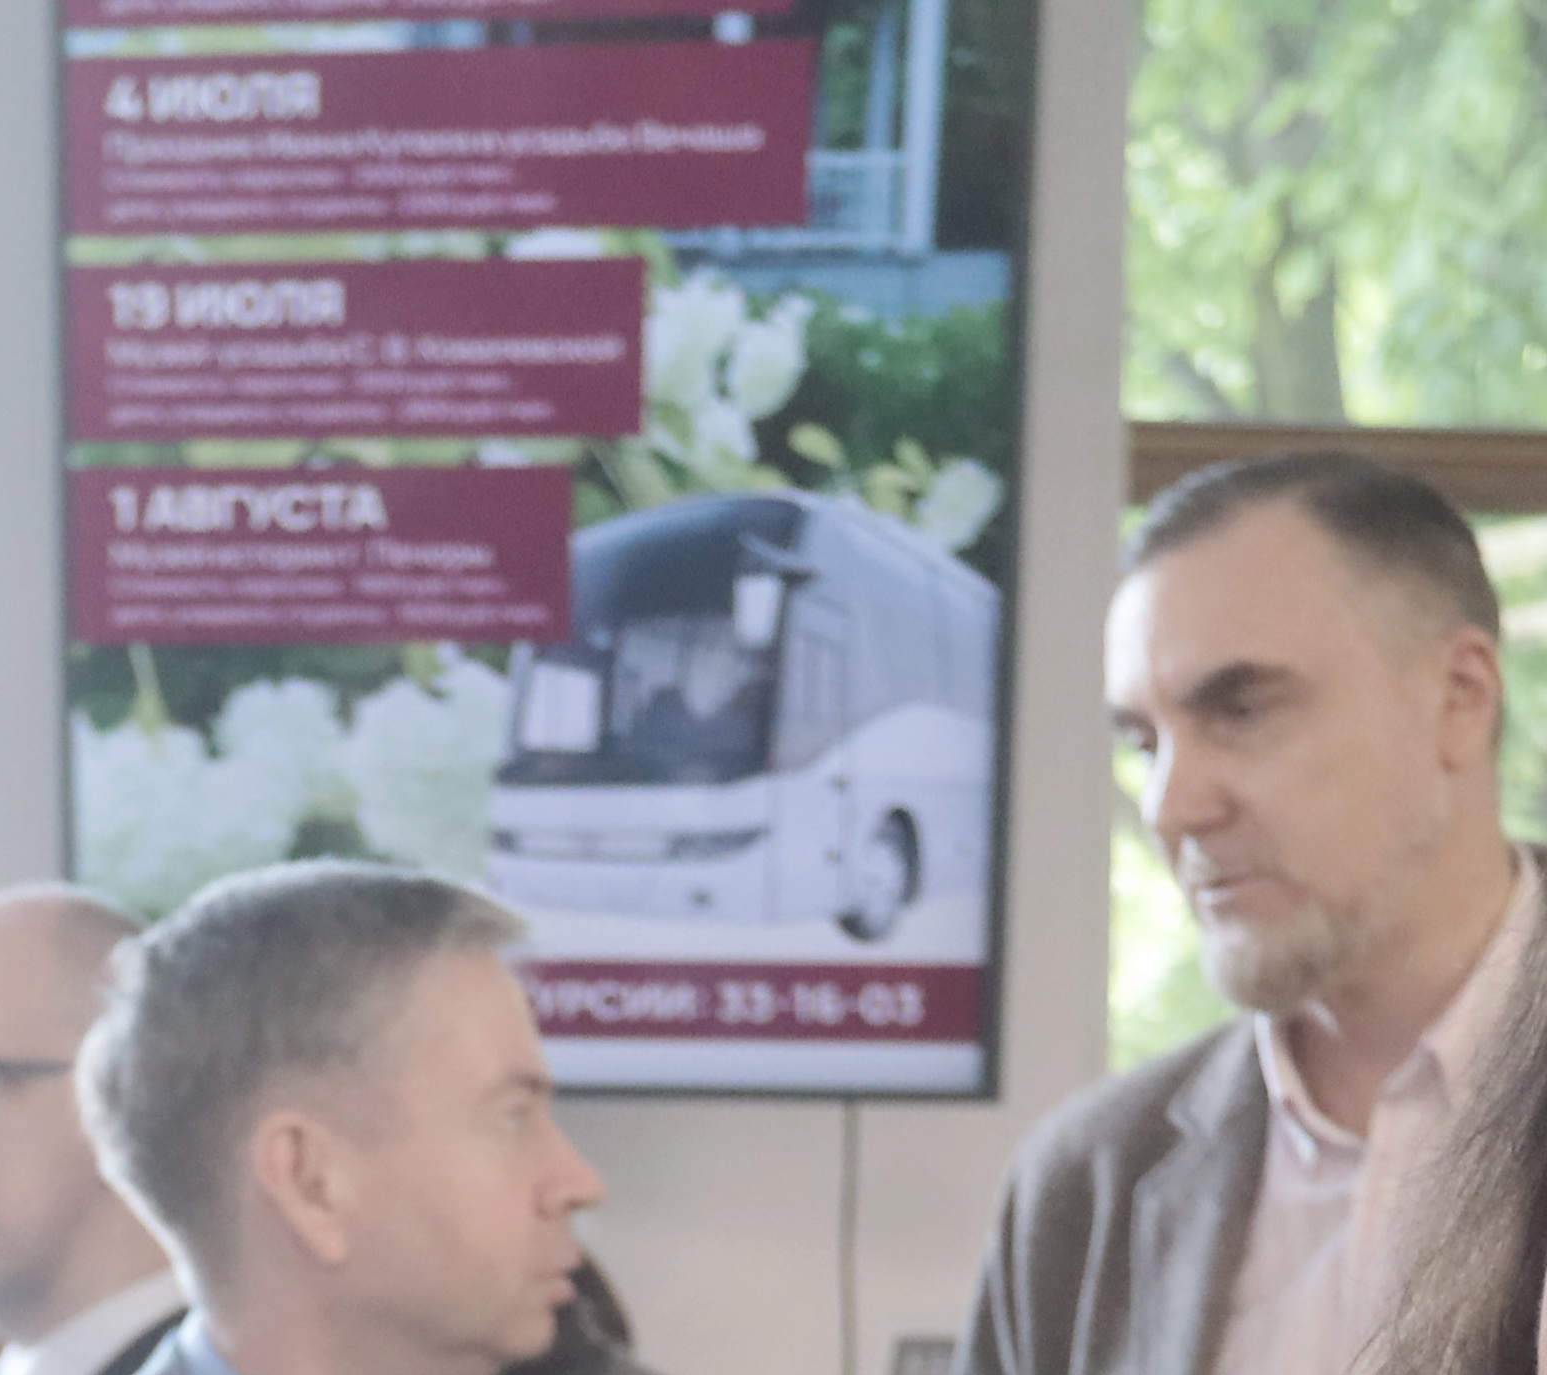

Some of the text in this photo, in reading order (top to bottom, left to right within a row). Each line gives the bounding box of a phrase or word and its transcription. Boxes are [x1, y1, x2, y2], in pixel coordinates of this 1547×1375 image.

[104, 71, 321, 123] 4 ИЮЛЯ
[110, 279, 345, 329] 19 ИЮЛЯ
[110, 483, 387, 531] 1 АВГУСТА
